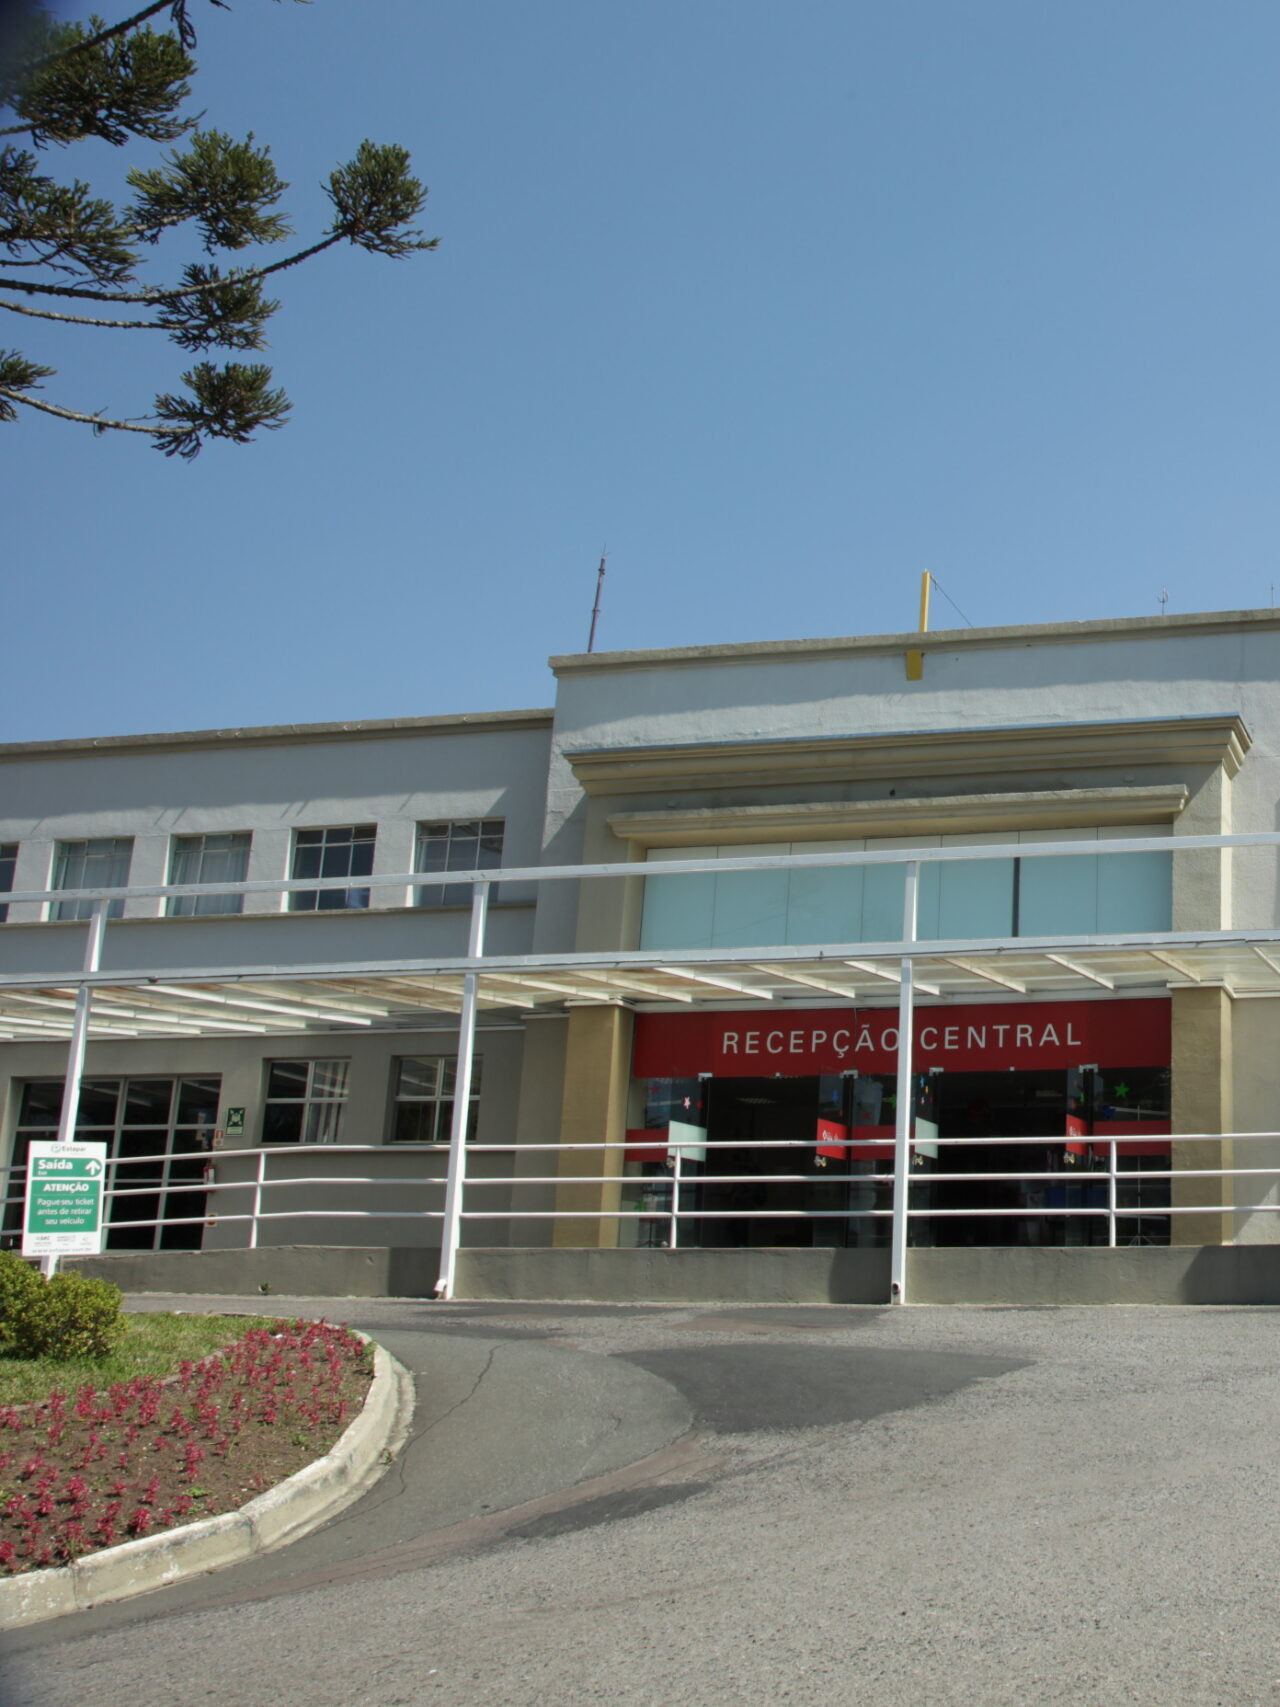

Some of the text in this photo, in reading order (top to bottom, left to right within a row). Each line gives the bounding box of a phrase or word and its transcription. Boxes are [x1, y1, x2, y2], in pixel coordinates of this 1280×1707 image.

[723, 1022, 1082, 1058] RECEPÇÃO CENTRAL
[37, 1158, 74, 1170] Saída
[43, 1182, 90, 1194] ATENÇÃO
[36, 1198, 60, 1207] Pague
[75, 1197, 94, 1206] ticket
[59, 1207, 69, 1215] de
[70, 1207, 92, 1215] retirar
[59, 1217, 85, 1225] veículo
